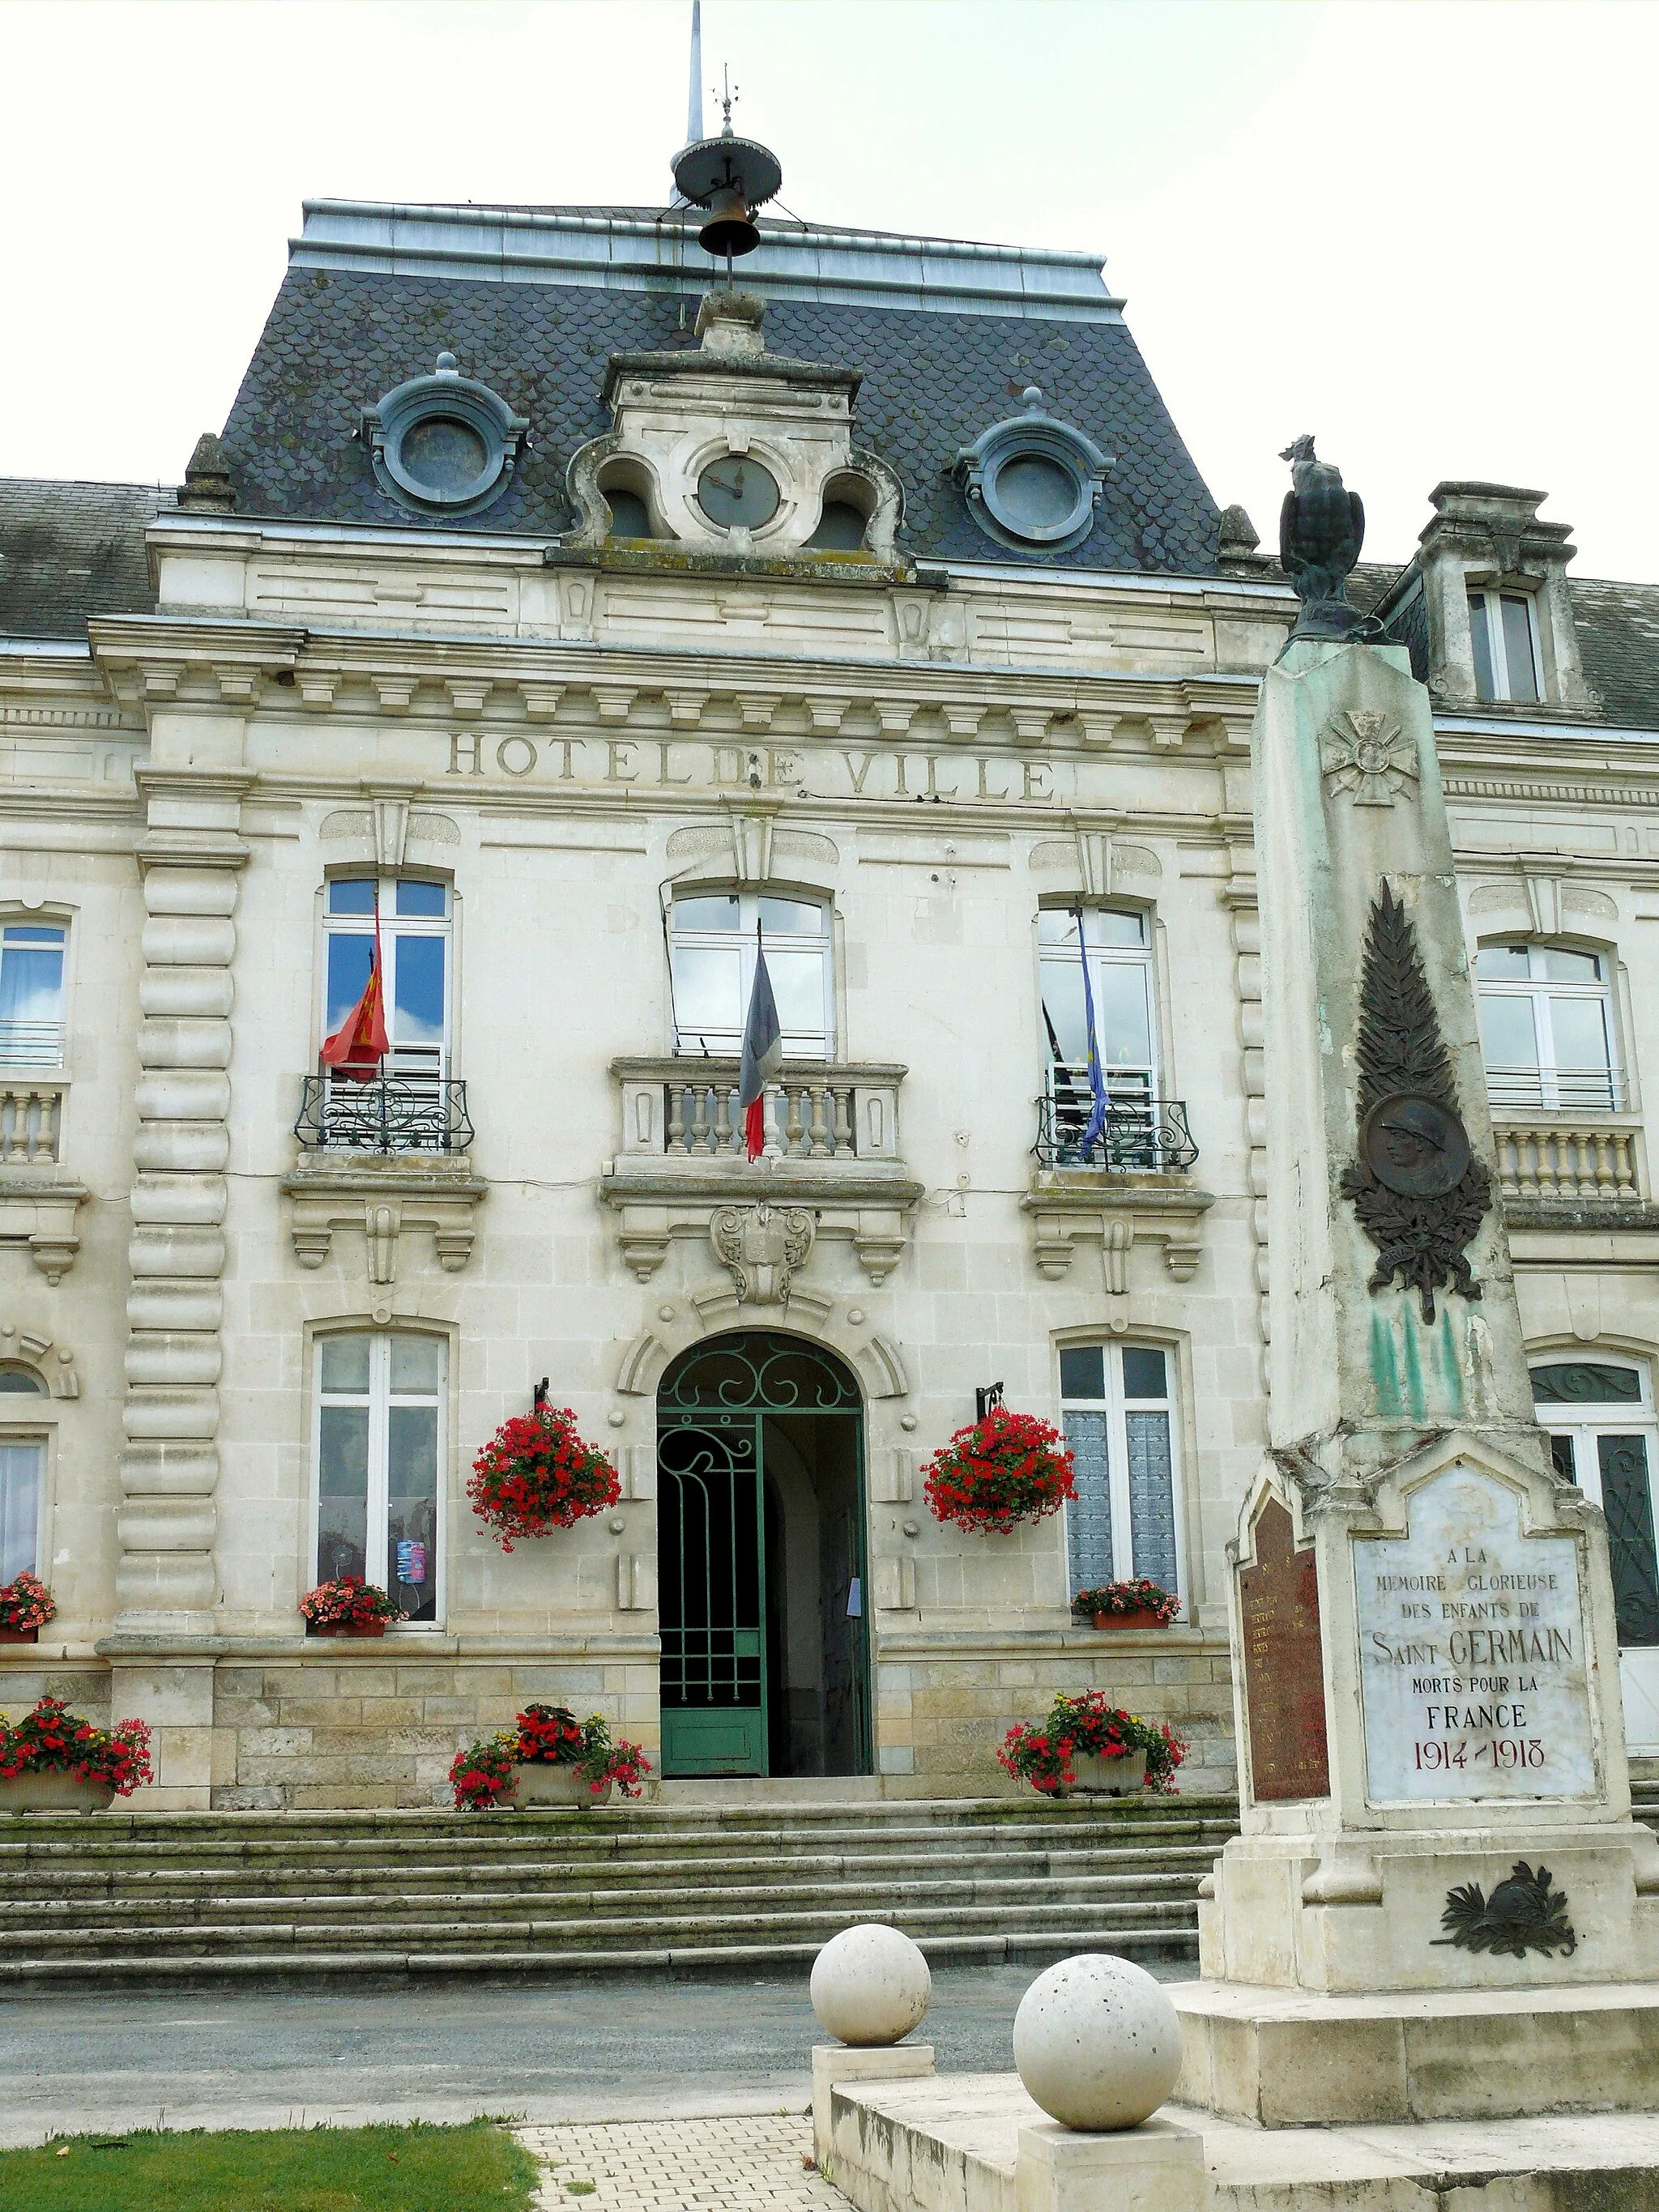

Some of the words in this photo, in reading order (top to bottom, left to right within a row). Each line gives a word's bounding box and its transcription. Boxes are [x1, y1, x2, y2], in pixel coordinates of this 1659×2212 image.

[445, 732, 693, 787] HOTEL
[707, 744, 805, 788] DE
[838, 752, 1054, 801] VILLE
[1447, 1548, 1457, 1563] A
[1465, 1547, 1487, 1563] LA
[1377, 1575, 1446, 1592] MEMOIRE
[1467, 1575, 1558, 1591] GLORIEUSE
[1402, 1603, 1431, 1619] DES
[1442, 1602, 1509, 1619] ENFANTS
[1519, 1601, 1539, 1617] DE
[1449, 1628, 1573, 1664] GERMAIN
[1412, 1677, 1462, 1694] MORTS
[1470, 1677, 1509, 1692] POUR
[1519, 1676, 1538, 1691] LA
[1427, 1704, 1527, 1729] FRANCE
